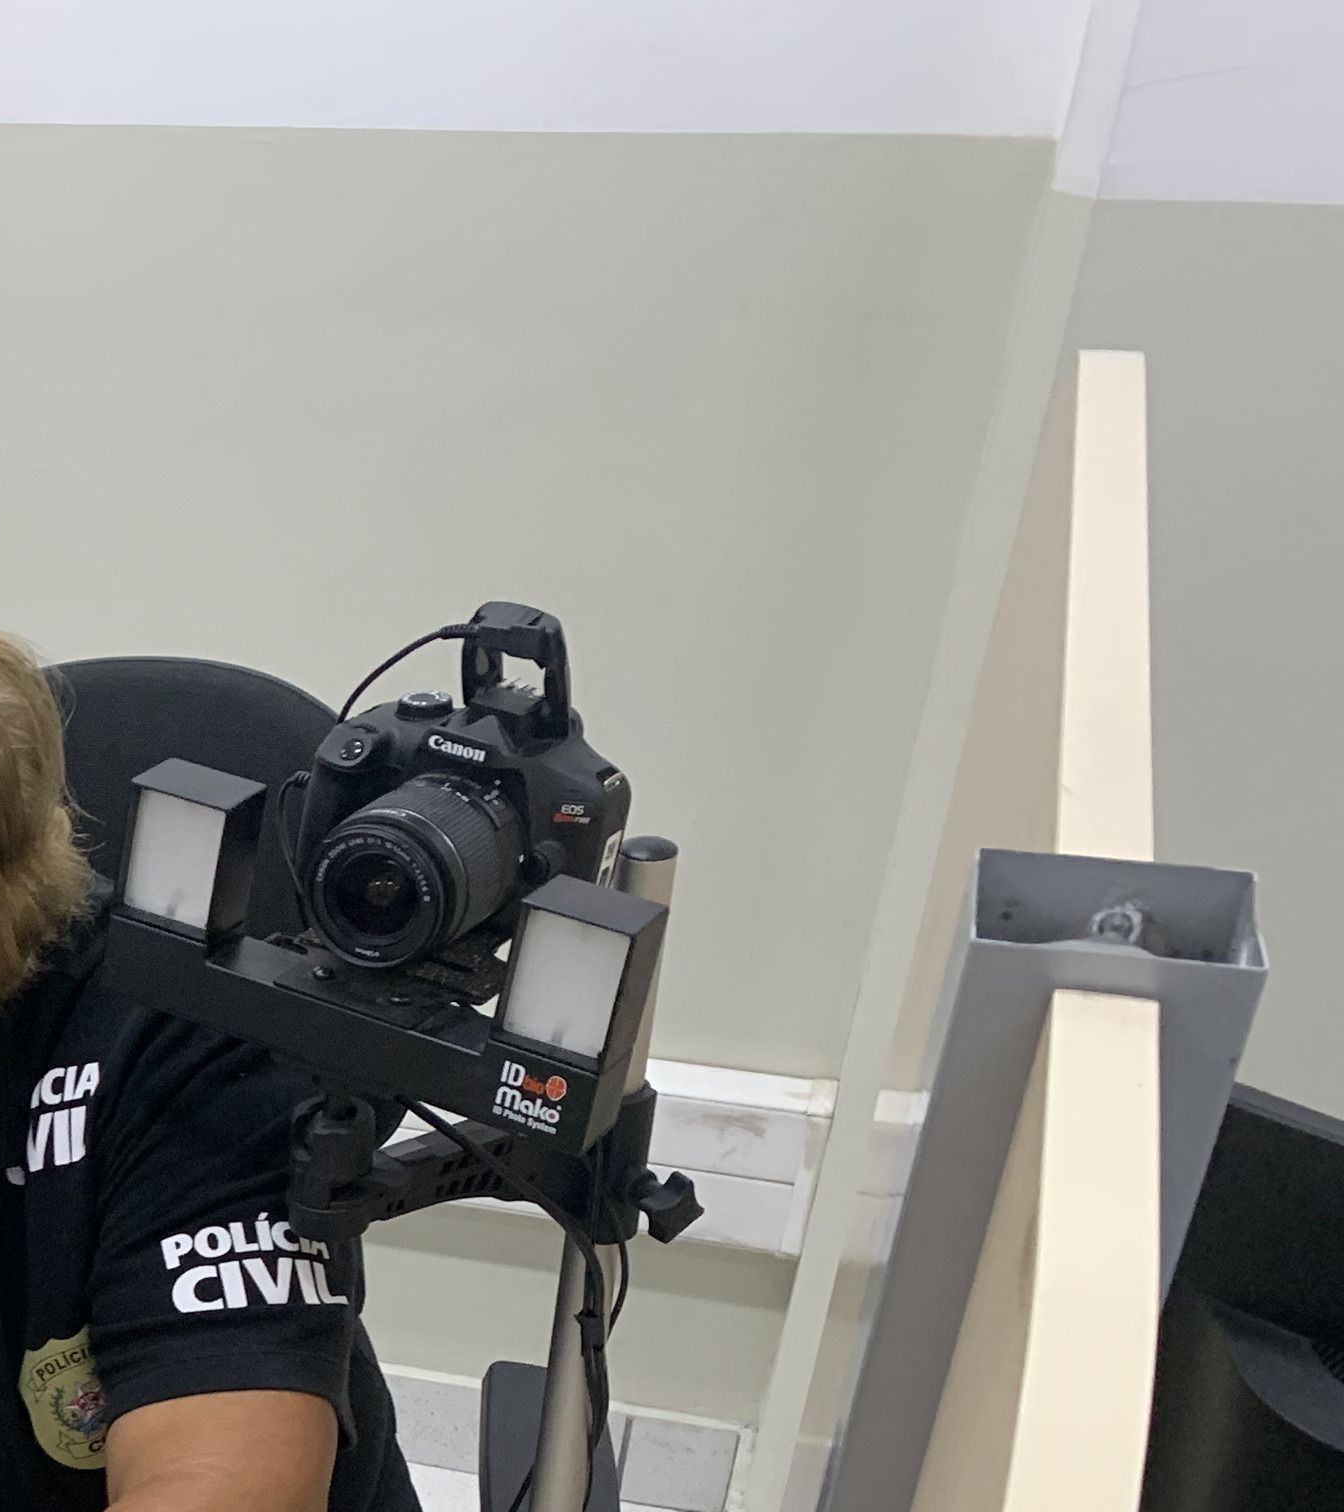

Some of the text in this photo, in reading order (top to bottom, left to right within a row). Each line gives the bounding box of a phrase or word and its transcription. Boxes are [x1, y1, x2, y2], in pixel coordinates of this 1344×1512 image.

[428, 734, 487, 763] Canon
[560, 803, 585, 816] EOS
[171, 1258, 350, 1315] CIVIL
